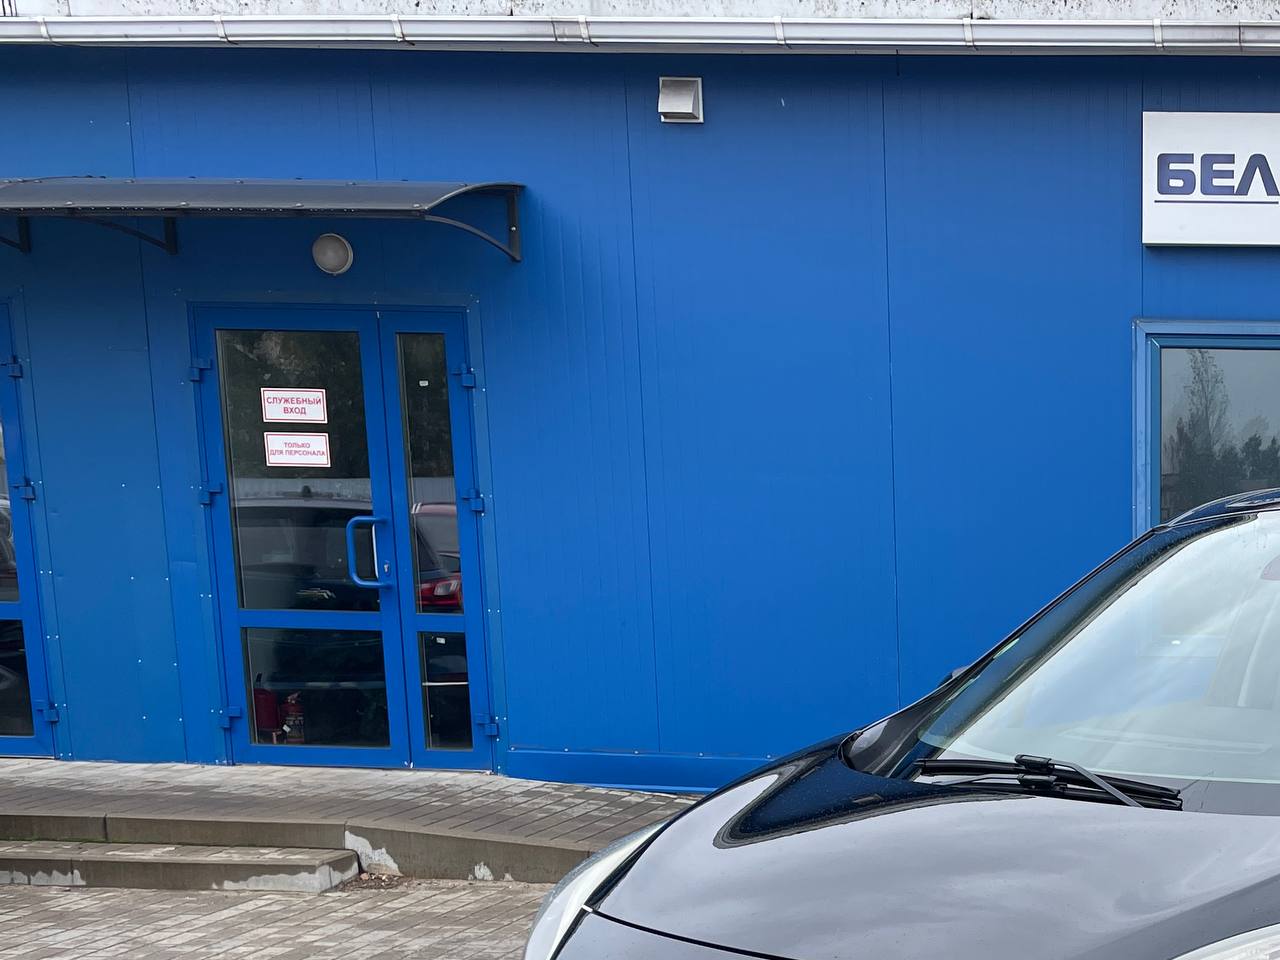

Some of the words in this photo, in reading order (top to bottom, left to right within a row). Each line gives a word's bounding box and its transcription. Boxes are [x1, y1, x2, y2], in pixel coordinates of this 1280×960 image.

[1156, 152, 1280, 198] БЕЛ
[266, 396, 322, 405] СЛУЖЕБНЫЙ
[283, 407, 306, 415] ВХОД
[285, 449, 326, 457] ПЕРСОНАЛА
